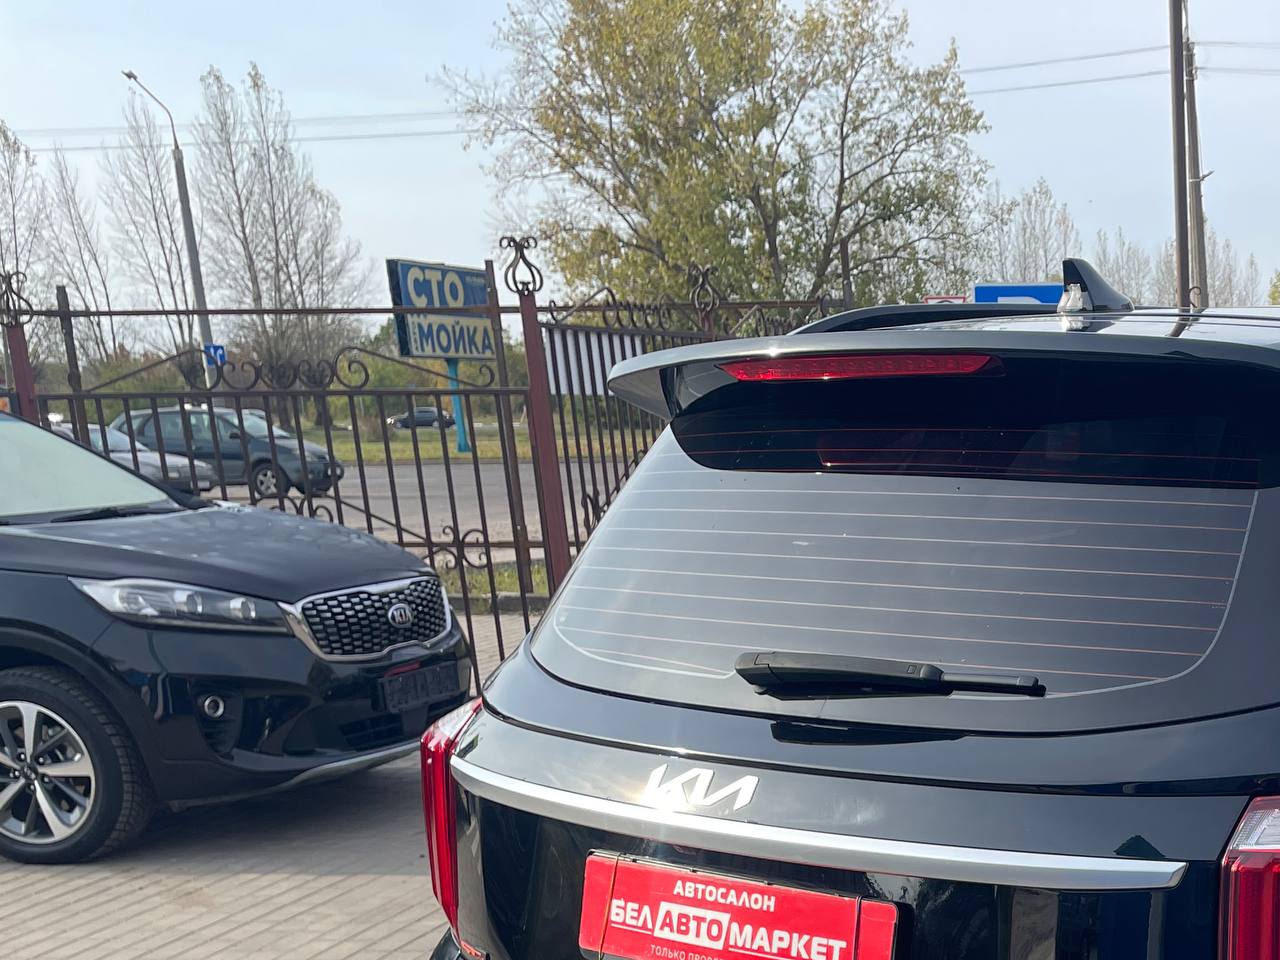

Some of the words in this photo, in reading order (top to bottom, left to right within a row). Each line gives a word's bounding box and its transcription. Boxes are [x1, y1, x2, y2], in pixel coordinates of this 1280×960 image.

[407, 266, 465, 309] СТО
[417, 318, 495, 355] МОЙКА
[673, 879, 776, 912] АВТОСАЛОН
[650, 944, 686, 960] ТОЛЬКО
